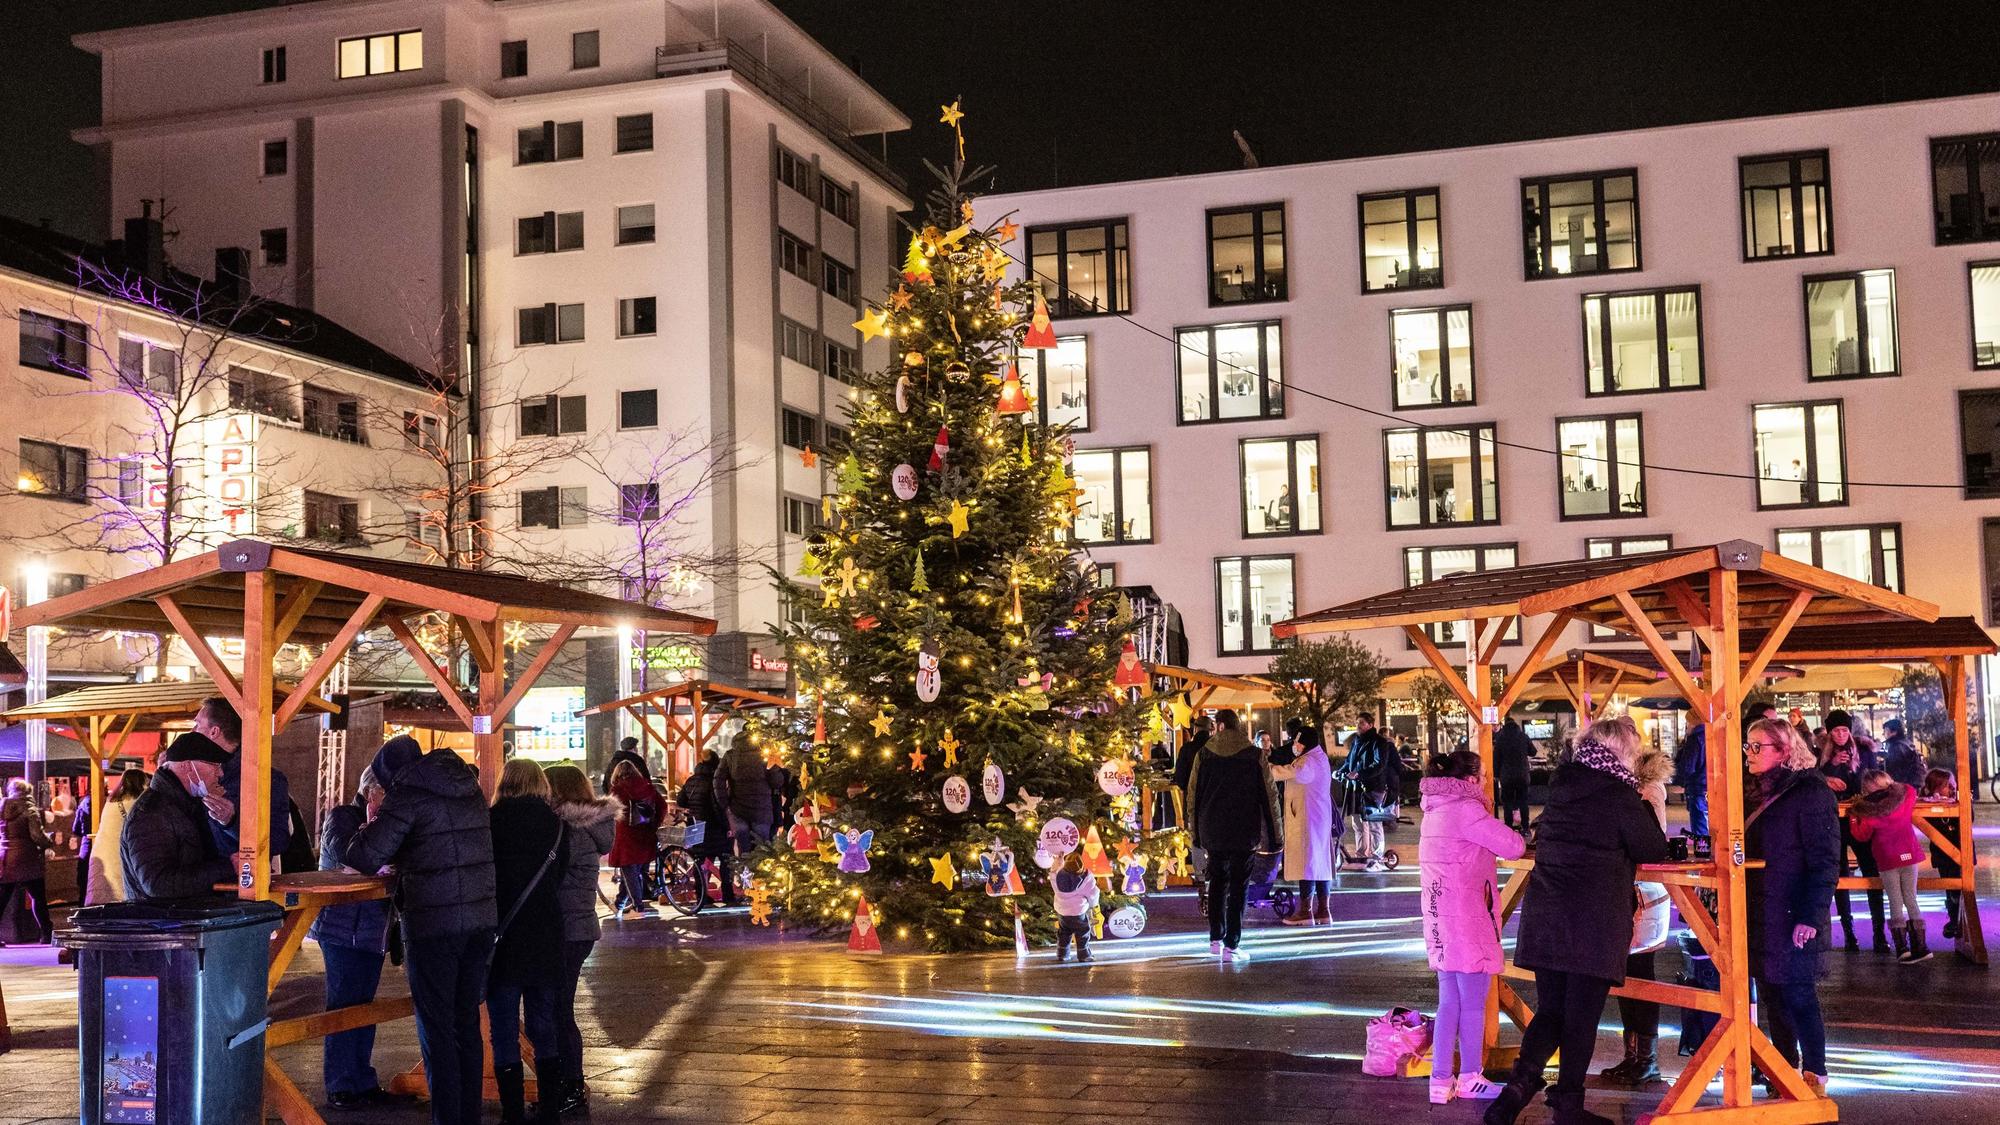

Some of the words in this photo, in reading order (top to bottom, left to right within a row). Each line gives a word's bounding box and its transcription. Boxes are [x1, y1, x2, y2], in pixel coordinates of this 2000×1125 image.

[221, 417, 246, 543] APOT
[762, 659, 788, 672] Sparkasse
[1045, 830, 1063, 839] 120
[1113, 918, 1130, 926] 120
